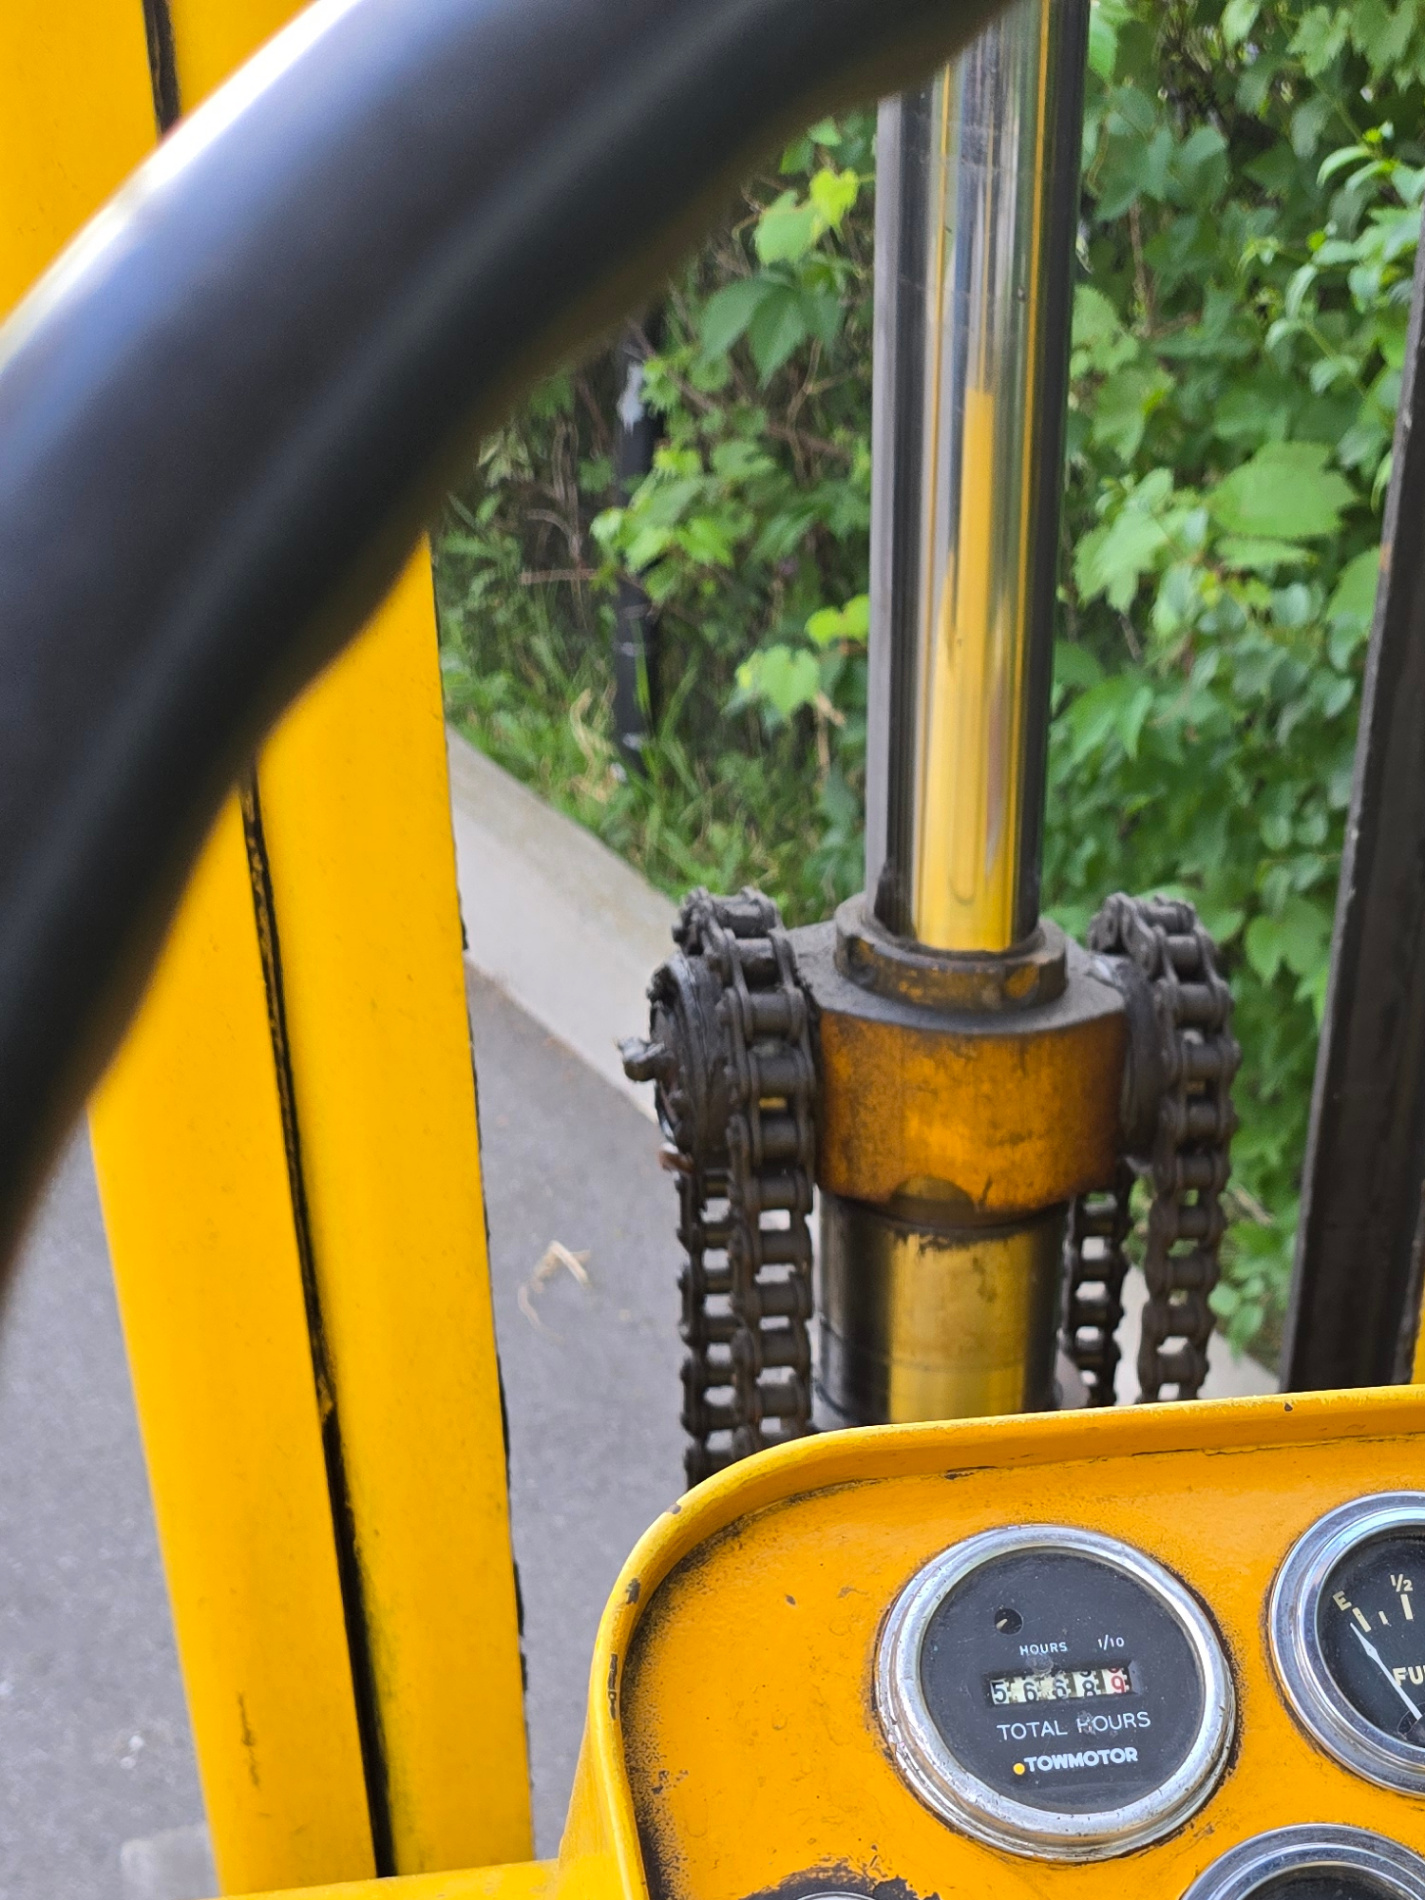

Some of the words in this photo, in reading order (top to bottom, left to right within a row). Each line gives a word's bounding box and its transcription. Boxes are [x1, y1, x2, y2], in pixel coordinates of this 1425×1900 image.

[1332, 1590, 1352, 1611] E
[1019, 1641, 1068, 1656] HOURS
[1097, 1634, 1125, 1651] 1/10
[996, 1720, 1068, 1741] TOTAL
[1076, 1711, 1152, 1734] HOURS
[1023, 1747, 1138, 1773] TOWMOTOR
